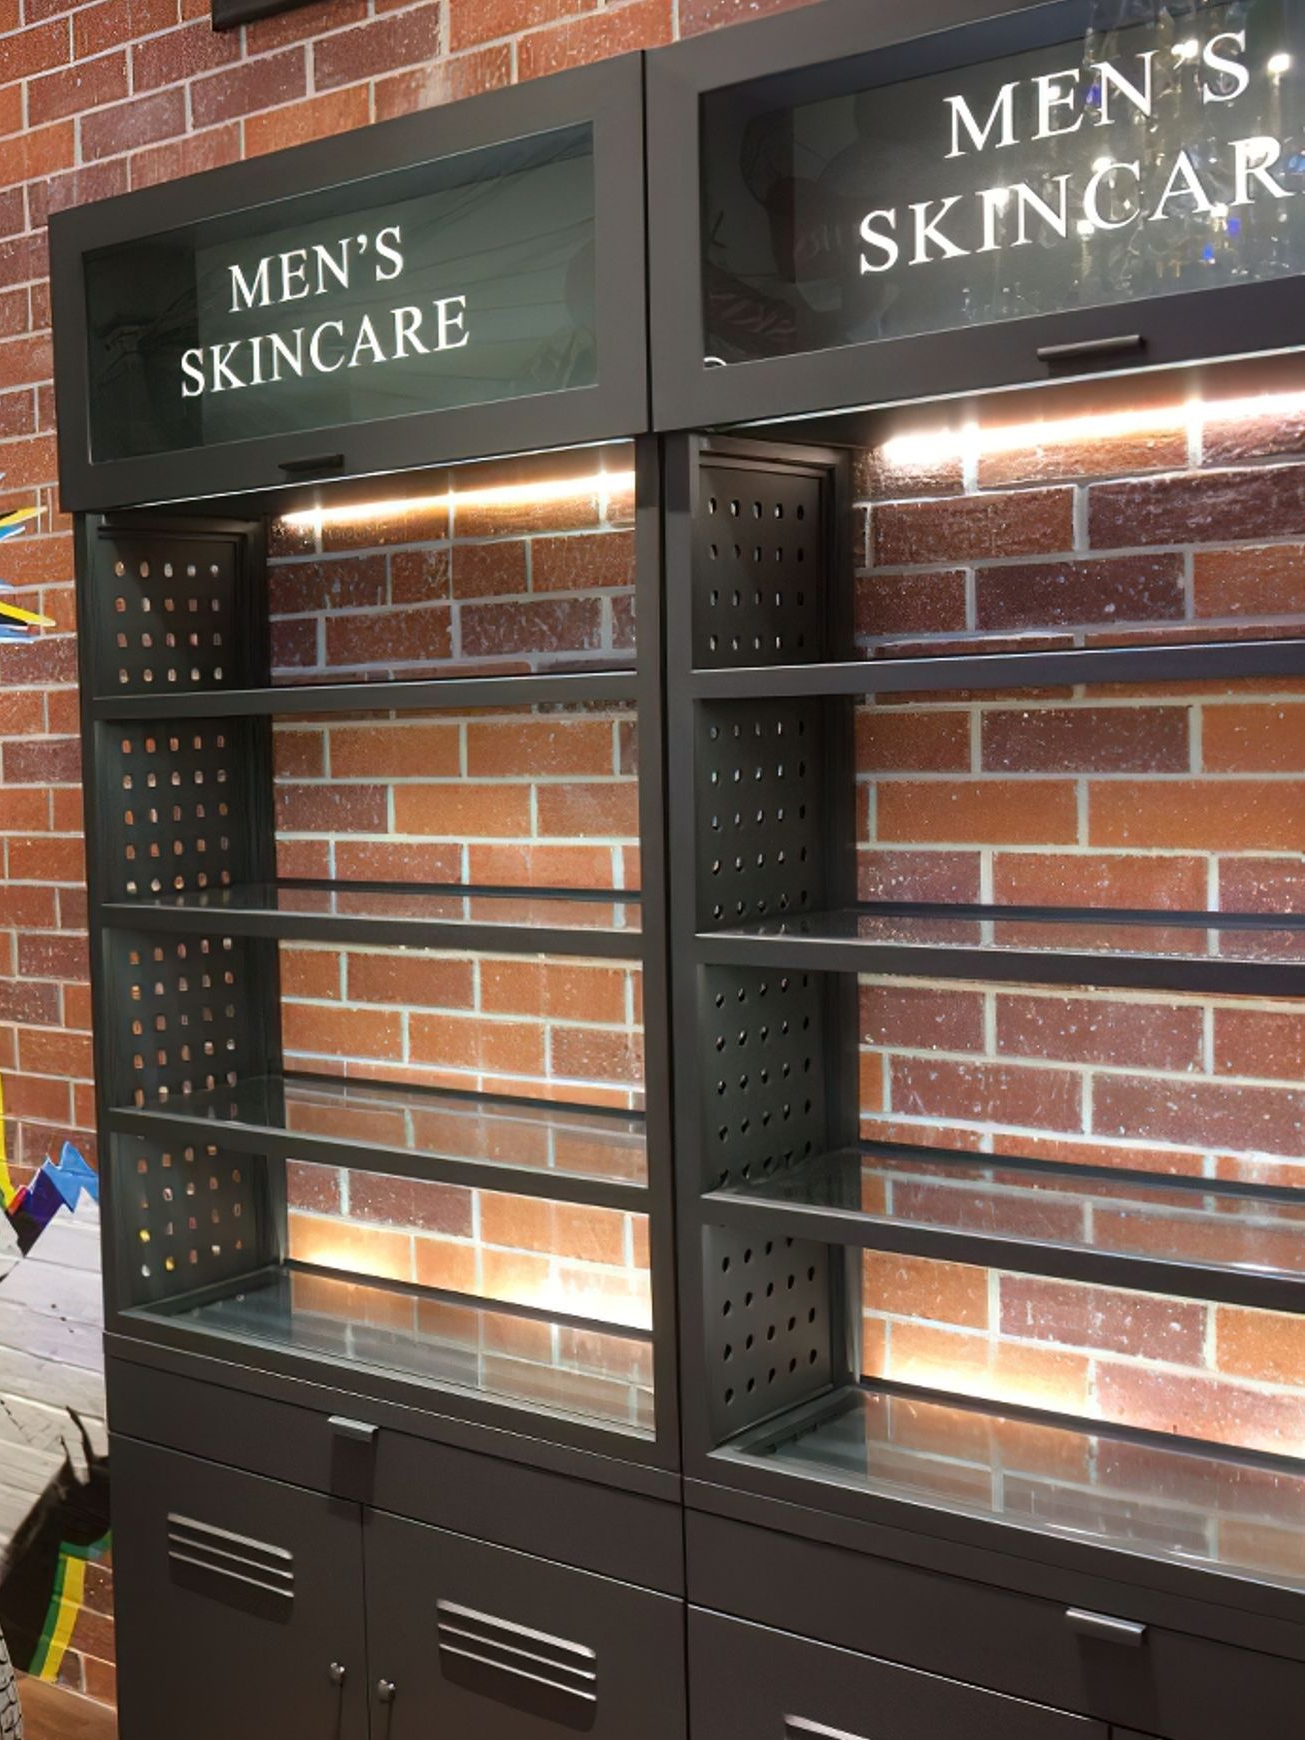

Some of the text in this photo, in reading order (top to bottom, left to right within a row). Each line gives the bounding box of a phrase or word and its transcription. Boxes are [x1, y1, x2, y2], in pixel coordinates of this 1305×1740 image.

[943, 30, 1250, 159] MEN'S
[859, 136, 1305, 275] SKINCAR
[228, 225, 404, 313] MEN'S
[181, 295, 470, 398] SKINCARE
